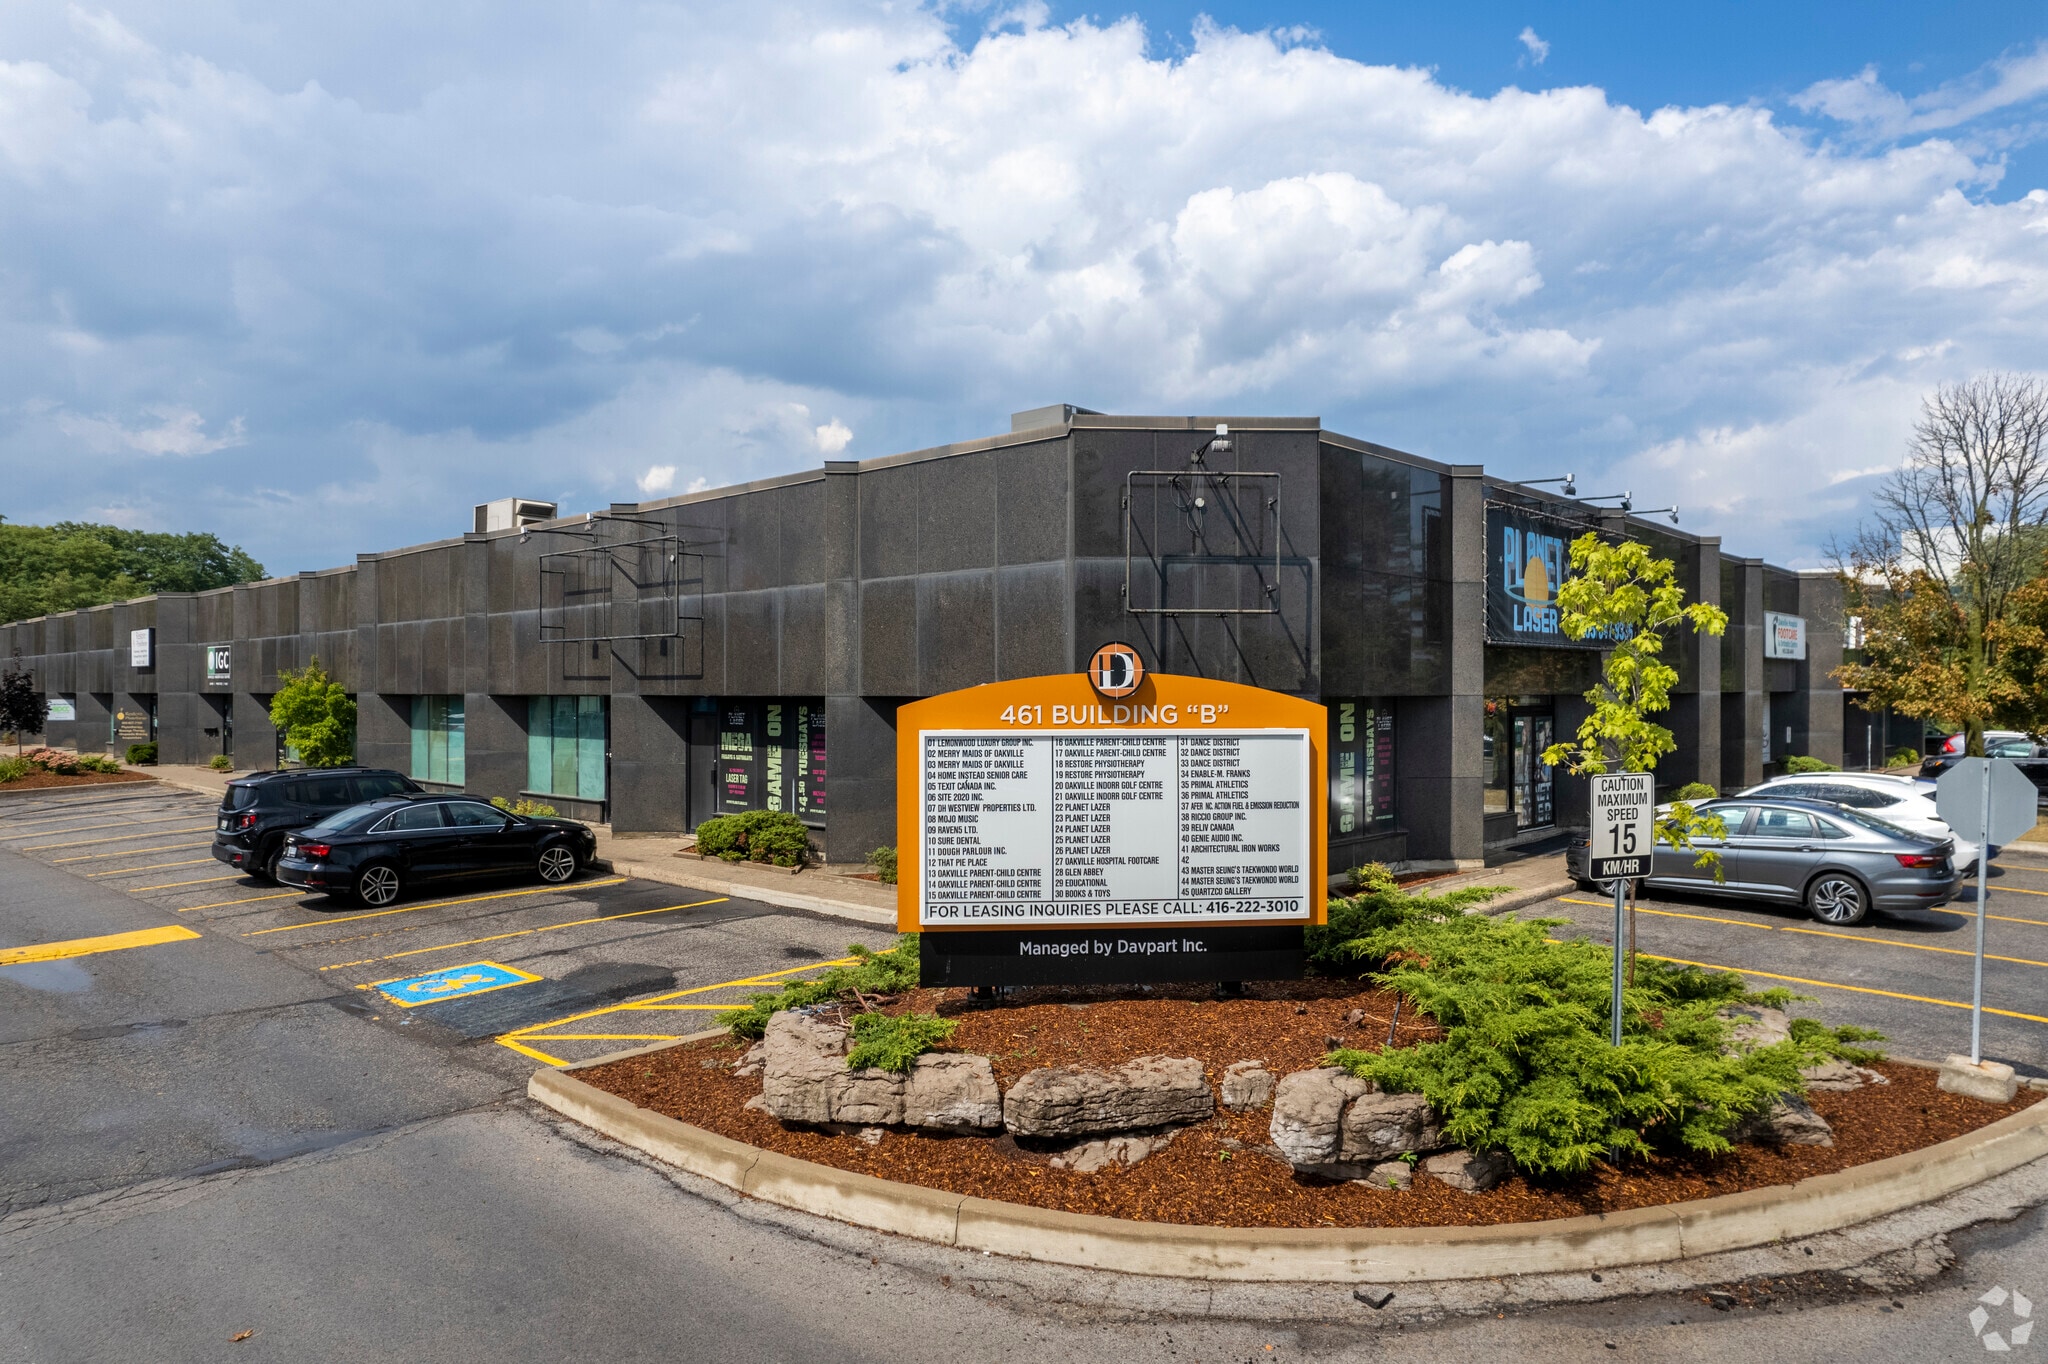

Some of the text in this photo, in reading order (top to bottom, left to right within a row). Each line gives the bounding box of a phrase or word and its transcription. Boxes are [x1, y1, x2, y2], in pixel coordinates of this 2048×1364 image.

[1504, 526, 1563, 592] PLANET
[1514, 604, 1558, 634] LASER
[216, 651, 229, 670] IGC
[1000, 704, 1042, 725] 461
[1053, 704, 1178, 724] BUILDING
[721, 732, 752, 752] MEGA
[799, 706, 808, 776] TUESDAYS
[1065, 738, 1094, 746] OAKVILLE
[1096, 738, 1140, 746] PARENT-CHILD
[1142, 738, 1166, 746] CENTRE
[1190, 738, 1211, 746] DANCE
[1213, 738, 1240, 746] DISTRICT
[768, 705, 781, 812] GAME ON
[1180, 759, 1240, 767] 33 DANCE DISTRICT
[1340, 703, 1355, 833] GAME ON
[928, 771, 1028, 780] 04 HOME INSTEAD SENIOR CARE
[1180, 770, 1189, 778] 34
[1226, 770, 1251, 778] FRANKS
[928, 782, 936, 790] 05
[938, 782, 955, 790] TEXIT
[984, 782, 996, 790] INC.
[1181, 780, 1248, 789] 35 PRIMAL ATHLETICS
[1601, 778, 1643, 792] CAUTION
[928, 793, 984, 802] 06 SITE 2020 INC.
[1598, 792, 1647, 807] MAXIMUM
[928, 804, 936, 812] 07
[948, 804, 980, 812] WESTVIEW
[983, 804, 1021, 812] PROPERTIES
[1022, 804, 1036, 812] LTD.
[1055, 803, 1111, 812] 22 PLANET LAZER
[938, 815, 956, 823] MOJO
[958, 815, 978, 823] MUSIC
[1065, 814, 1089, 822] PLANET
[1090, 814, 1111, 822] LAZER
[1181, 812, 1247, 821] 38 RICCIO GROUP INC.
[1607, 808, 1638, 821] SPEED
[928, 826, 936, 834] 09
[964, 826, 978, 834] LTD.
[1181, 823, 1234, 832] 39 RELIV CANADA
[928, 837, 981, 845] 10 SURE DENTAL
[1181, 834, 1243, 842] 40 GENIE AUDIO INC.
[1609, 823, 1636, 854] 15
[928, 847, 1007, 856] 11 DOUGH PARLOUR INC.
[1181, 844, 1280, 853] 41 ARCHITECTURAL IRON WORKS
[928, 858, 988, 867] 12 THAT PIE PLACE
[1055, 856, 1160, 865] 27 OAKVILLE HOSPITAL FOOTCARE
[1181, 855, 1189, 864] 42
[1181, 866, 1189, 875] 43
[1191, 866, 1214, 874] MASTER
[1242, 865, 1277, 874] TAEKWONDO
[1278, 865, 1299, 874] WORLD
[1603, 859, 1639, 875] KM/HR
[928, 869, 1041, 878] 13 OAKVILLE PARENT-CHILD CENTRE
[1055, 868, 1104, 876] 28 GLEN ABBEY
[1065, 879, 1108, 887] EDUCATIONAL
[928, 890, 1041, 900] 15 OAKVILLE PARENT-CHILD CENTRE
[1055, 890, 1111, 898] 30 BOOKS & TOYS
[1181, 888, 1189, 896] 45
[1224, 887, 1252, 896] GALLERY
[930, 900, 1299, 918] FOR LEASING INQUIRIES PLEASE CALL: 416-222-3010
[1020, 938, 1207, 957] Managed by Davpart Inc.
